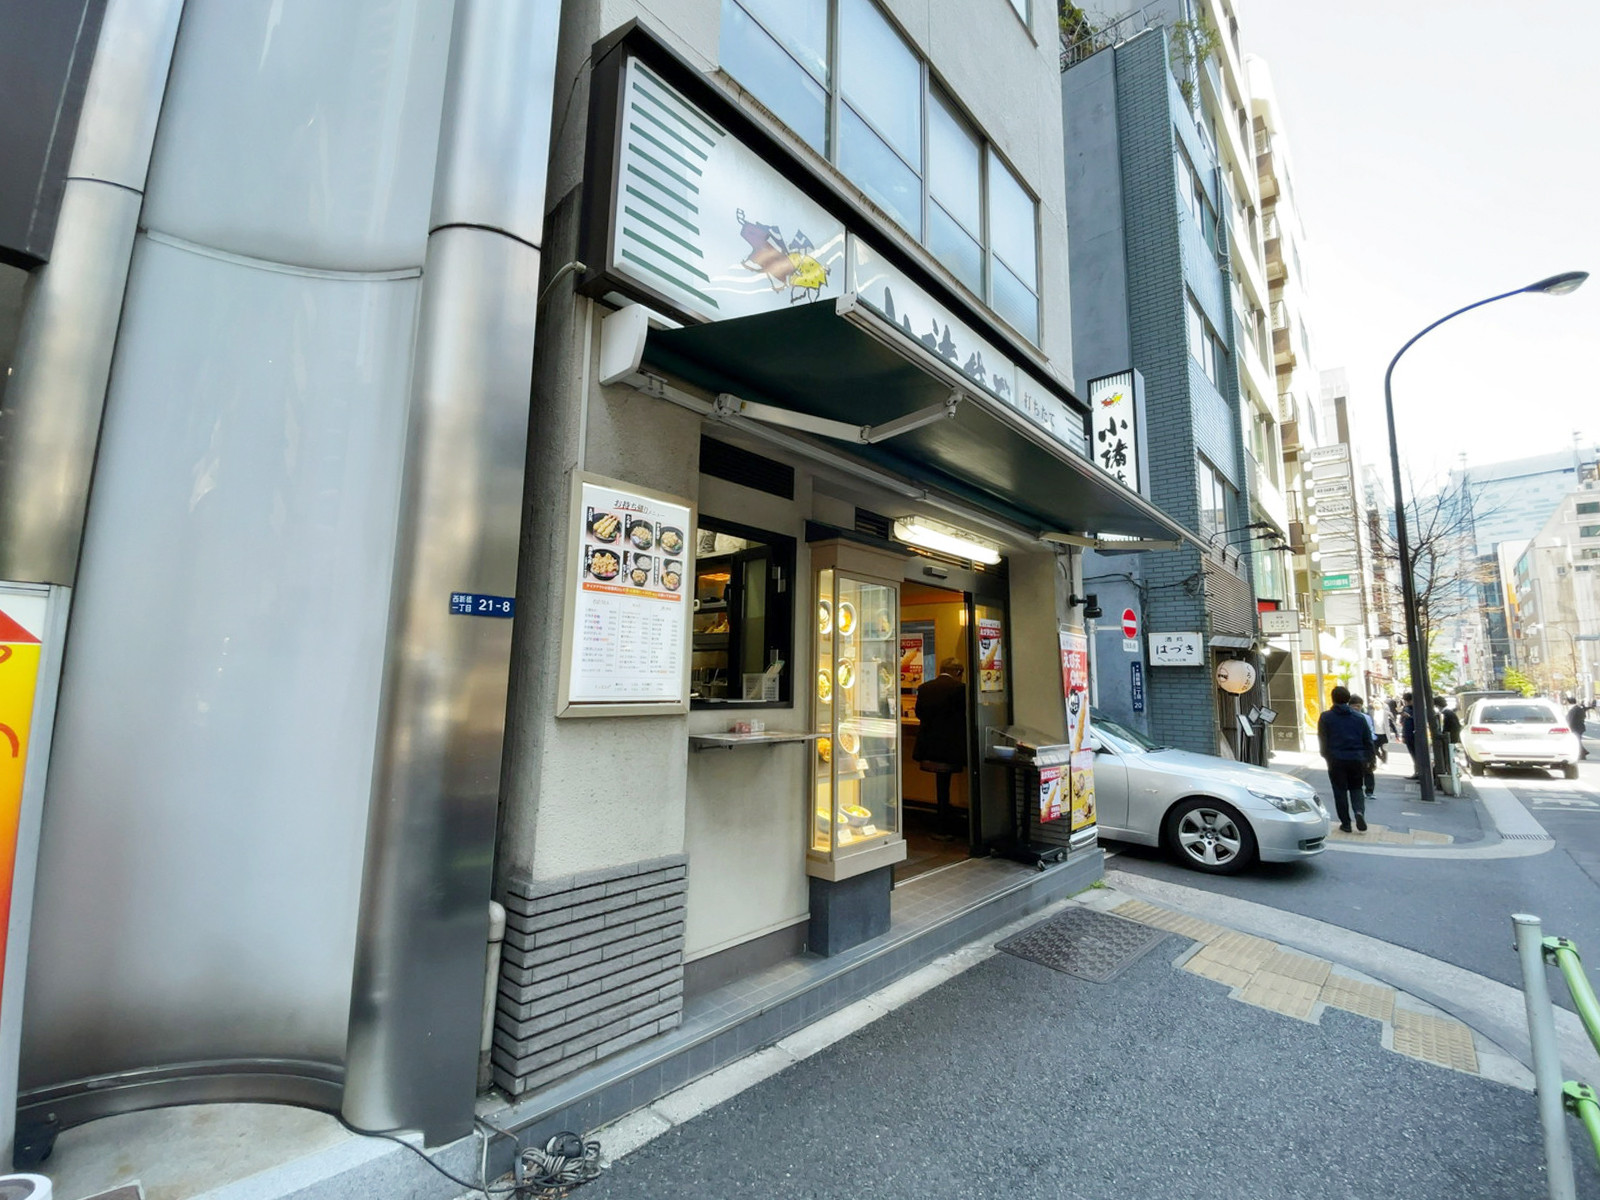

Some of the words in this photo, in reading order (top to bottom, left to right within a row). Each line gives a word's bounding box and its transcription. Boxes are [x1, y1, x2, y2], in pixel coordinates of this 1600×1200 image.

[1024, 391, 1056, 428] 打ちたて
[452, 595, 473, 604] 西新橋
[452, 604, 472, 613] 一丁目
[478, 598, 511, 613] 21-8
[1155, 644, 1195, 655] はづき
